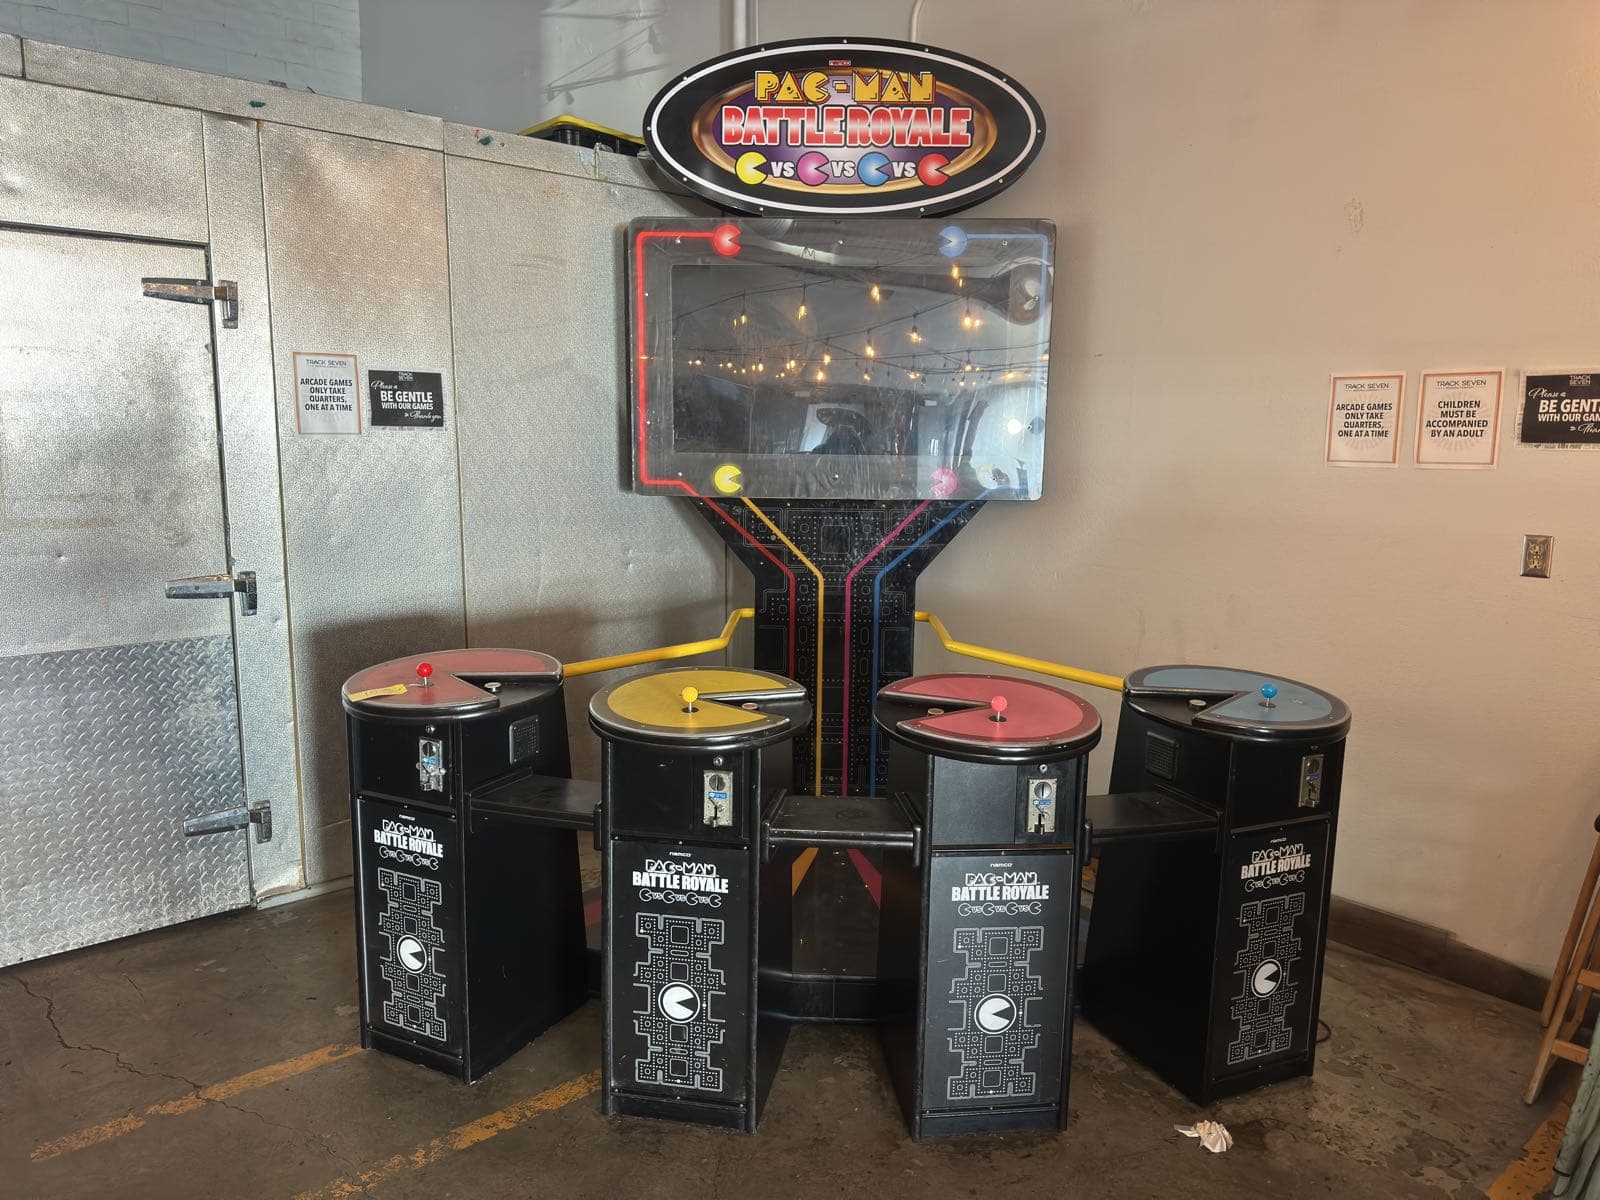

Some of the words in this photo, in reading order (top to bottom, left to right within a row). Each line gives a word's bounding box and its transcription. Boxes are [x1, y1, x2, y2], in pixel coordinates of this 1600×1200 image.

[755, 70, 936, 105] PAC-MAN
[721, 105, 847, 147] BATTLE
[846, 106, 973, 147] ROYALE
[770, 161, 796, 178] VS
[831, 161, 856, 178] VS
[892, 161, 917, 178] VS
[300, 378, 328, 386] ARCADE
[329, 379, 353, 387] GAMES
[310, 386, 328, 394] ONLY
[329, 387, 346, 395] TAKE
[1528, 387, 1558, 399] Please
[310, 395, 347, 403] QUARTERS,
[380, 390, 394, 402] BE
[395, 390, 434, 403] GENTLE
[305, 403, 320, 411] ONE
[321, 403, 330, 411] AT
[336, 404, 353, 412] TIME
[381, 402, 398, 410] WITH
[398, 402, 412, 410] OUR
[412, 402, 434, 411] GAMES
[1336, 403, 1365, 411] ARCADE
[1366, 403, 1393, 411] GAMES
[1438, 400, 1481, 409] CHILDREN
[1539, 399, 1558, 413] BE
[1560, 398, 1600, 413] GENT
[410, 411, 432, 420] Thank
[1345, 412, 1364, 420] ONLY
[1366, 412, 1384, 420] TAKE
[1440, 410, 1464, 418] MUST
[1465, 410, 1477, 418] BE
[1538, 413, 1560, 422] WITH
[1561, 413, 1581, 422] OUR
[1582, 413, 1600, 422] GAM
[1344, 421, 1384, 430] QUARTERS,
[1426, 420, 1489, 428] ACCOMPANIED
[1338, 430, 1353, 438] ONE
[1354, 430, 1364, 438] AT
[1371, 430, 1389, 438] TIME
[1431, 429, 1441, 437] BY
[1443, 429, 1455, 437] AN
[1456, 429, 1484, 437] ADULT
[382, 819, 435, 842] PAC-MAN
[374, 828, 409, 850] BATTLE
[408, 837, 443, 858] ROYALE
[1252, 844, 1304, 863] PAC-MAN
[645, 859, 717, 878] PAC-MAN
[1241, 860, 1277, 879] BATTLE
[1277, 854, 1311, 873] ROYALE
[632, 871, 680, 889] BATTLE
[681, 875, 728, 893] ROYALE
[965, 872, 1038, 886] PAC-MAN
[951, 886, 1000, 901] BATTLE
[1002, 885, 1049, 900] ROYALE
